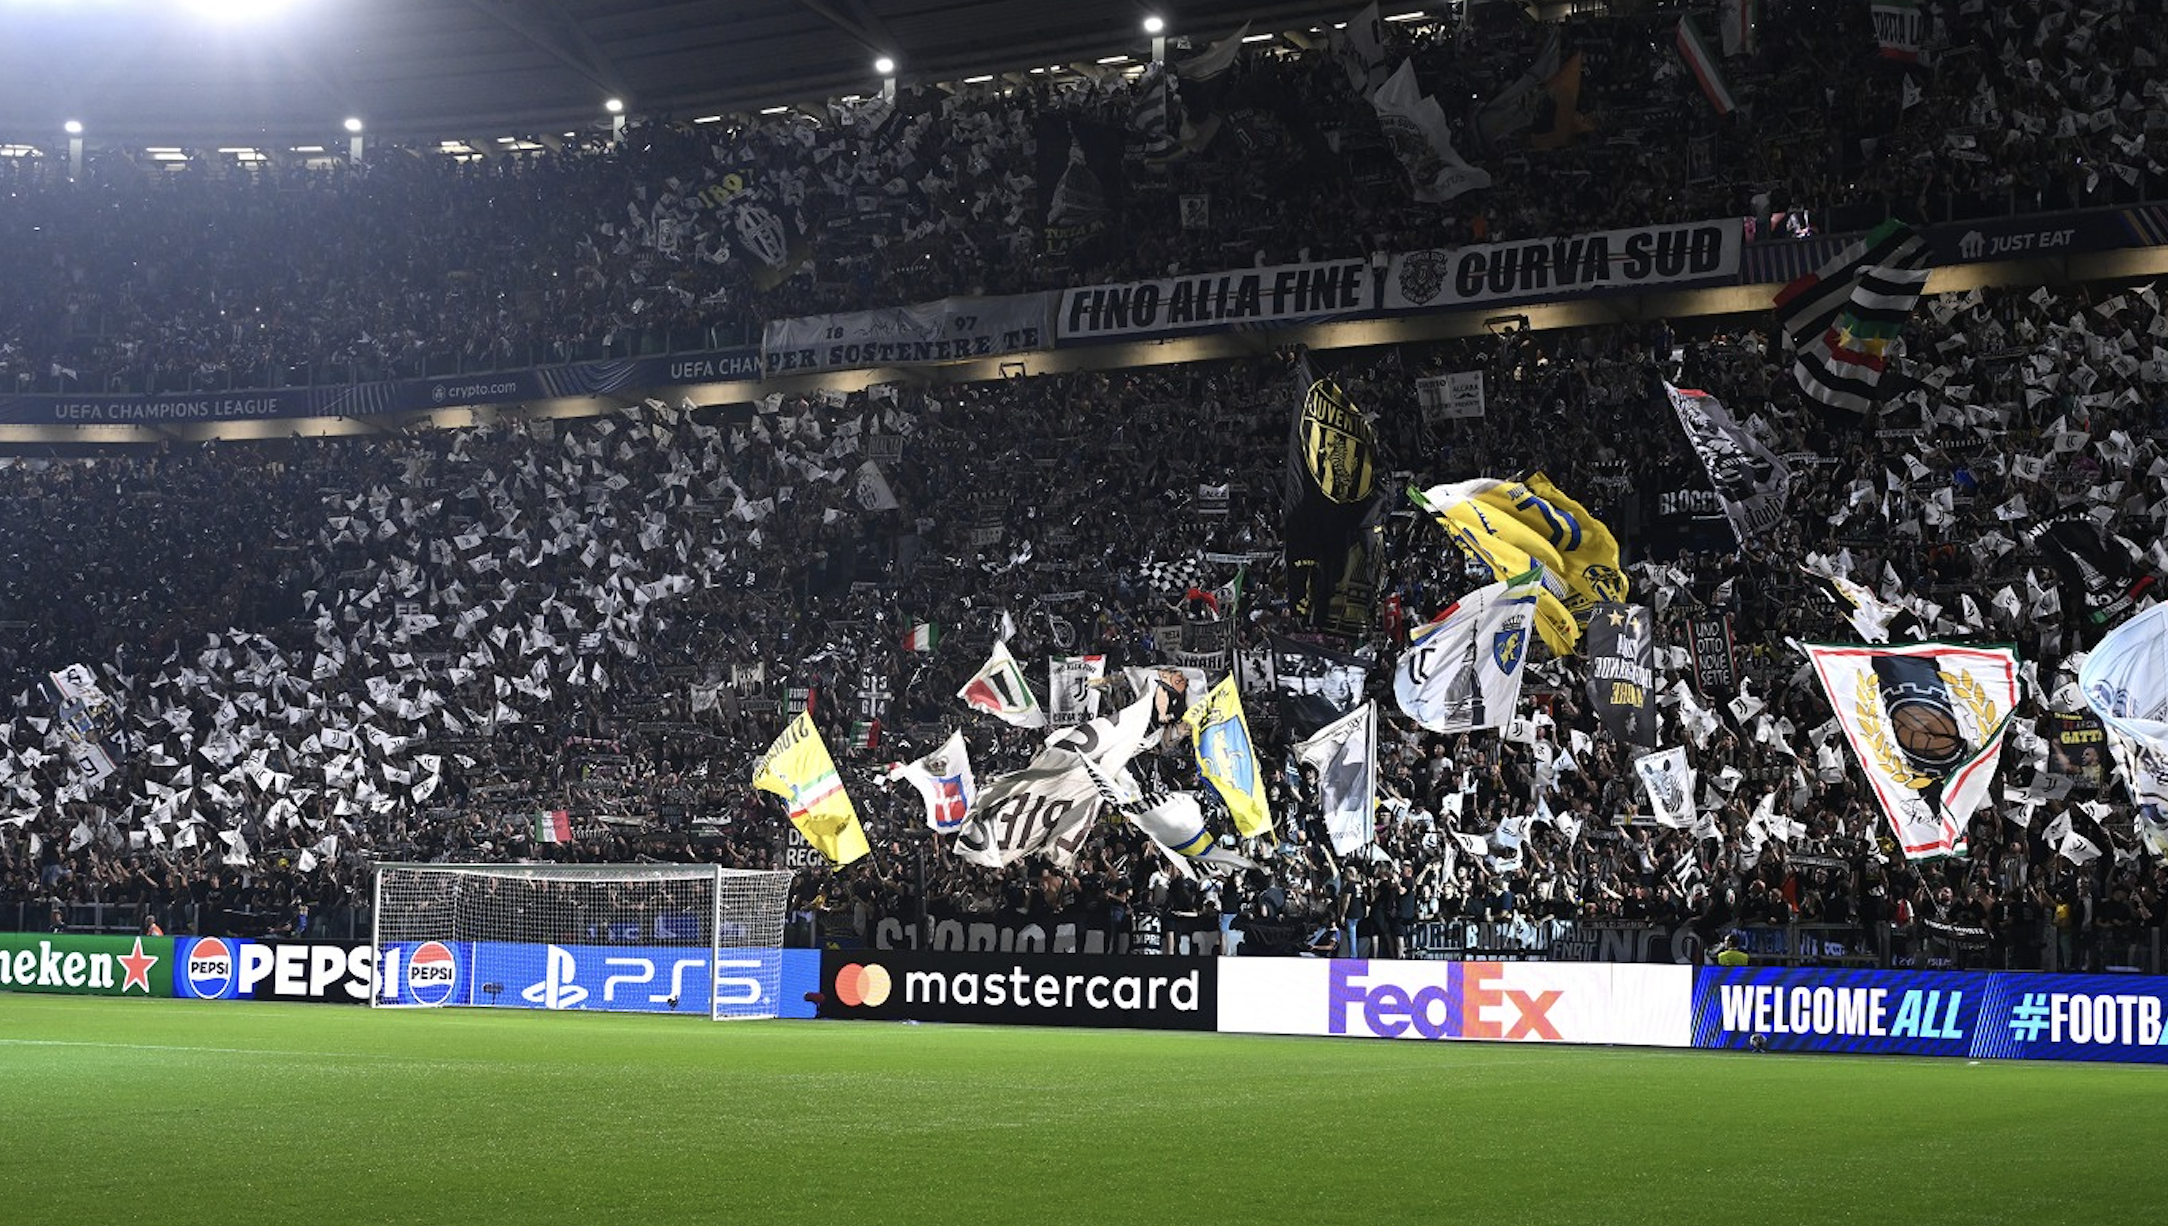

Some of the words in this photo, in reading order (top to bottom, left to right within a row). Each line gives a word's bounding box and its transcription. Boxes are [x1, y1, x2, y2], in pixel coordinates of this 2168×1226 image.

[1989, 233, 2035, 255] JUST
[2038, 229, 2075, 247] EAT
[1455, 235, 1611, 298] CURVA
[1623, 226, 1723, 280] SUD
[1069, 284, 1160, 333] FINO
[1167, 275, 1261, 323] ALLA
[1272, 264, 1366, 315] FINE
[825, 326, 844, 339] 18
[954, 316, 978, 331] 97
[768, 350, 816, 370] PER
[829, 334, 992, 364] SOSTENERE
[1003, 327, 1038, 350] TE
[671, 362, 714, 380] UEFA
[449, 381, 517, 398] crypto.com
[55, 404, 102, 419] UEFA
[108, 401, 209, 419] CHAMPIONS
[214, 398, 278, 416] LEAGUE
[1306, 391, 1372, 444] JUVENTU
[1695, 621, 1720, 637] UNO
[1697, 637, 1723, 653] OTTO
[1699, 653, 1727, 669] NOVE
[1700, 669, 1730, 686] SETTE
[190, 962, 229, 976] PEPSI
[238, 943, 400, 998] PEPSI
[410, 967, 454, 981] PEPSI
[603, 958, 765, 1004] PS5
[905, 965, 1200, 1011] mastercard
[1328, 958, 1566, 1040] FedEx
[1720, 984, 1888, 1036] WELCOME
[1889, 989, 1964, 1040] ALL
[2008, 992, 2168, 1046] #FOOTB
